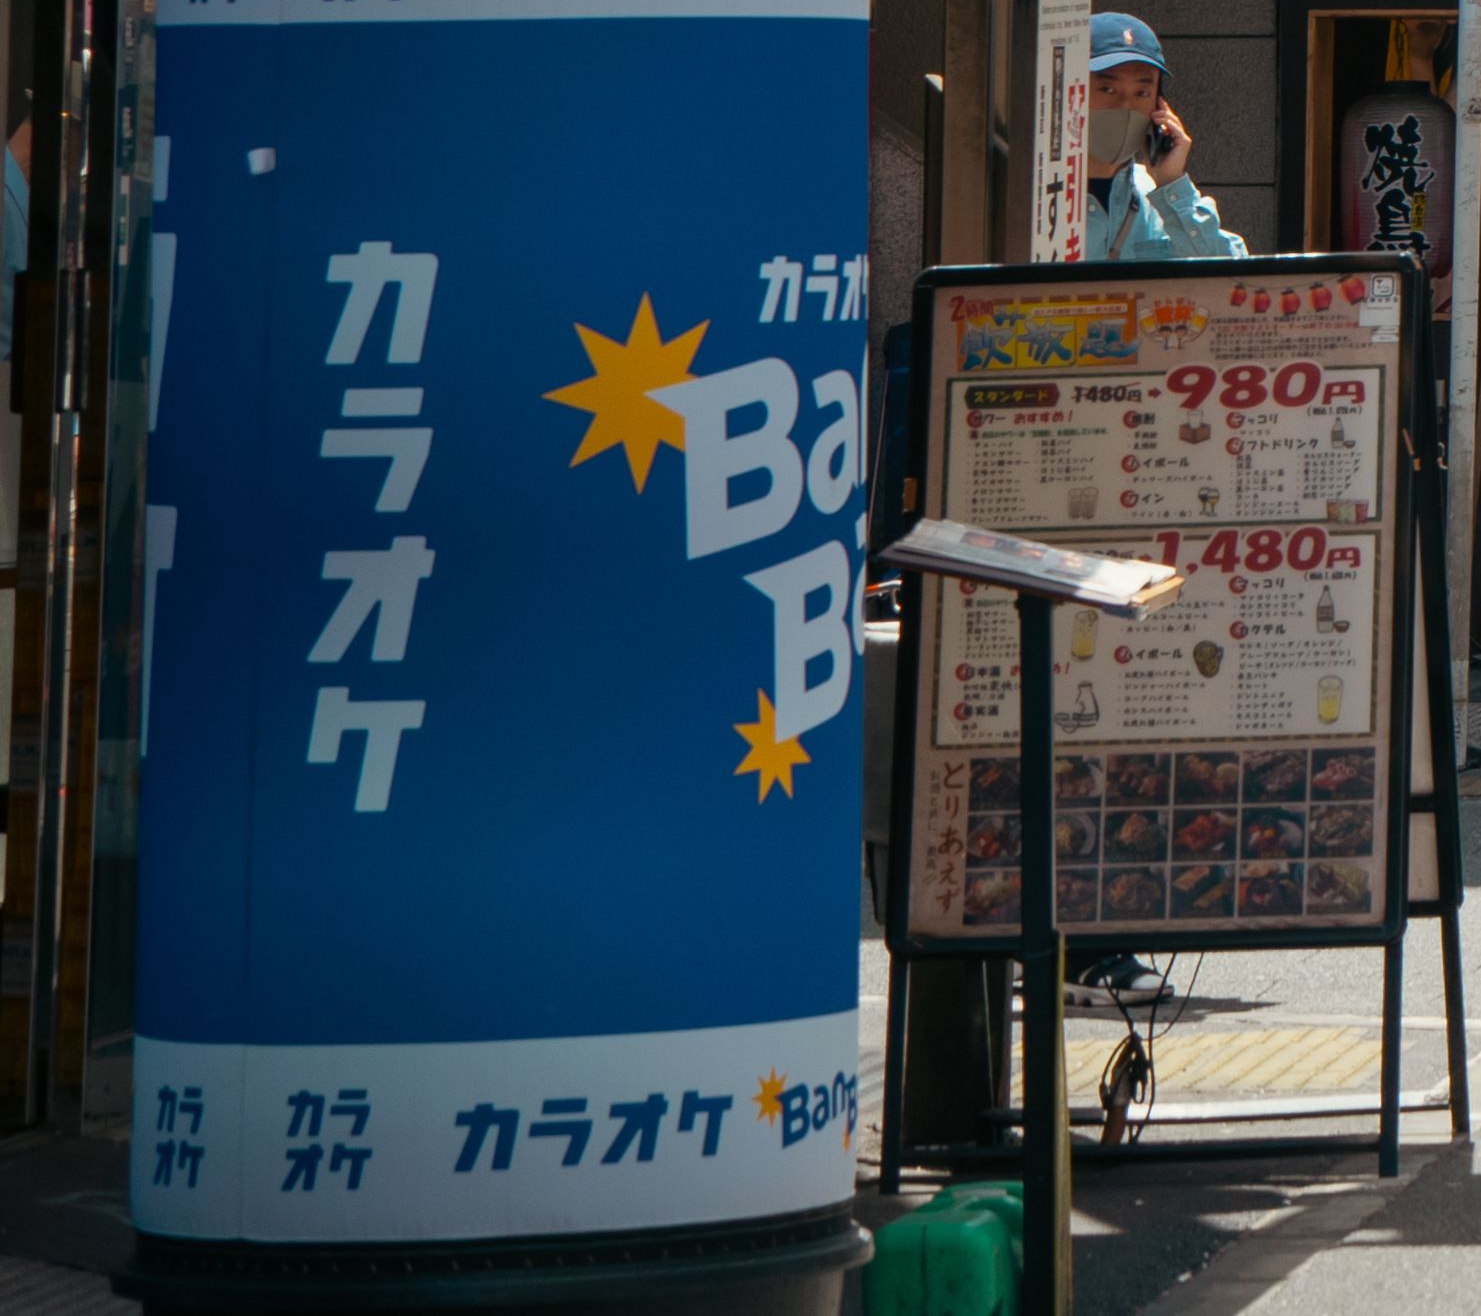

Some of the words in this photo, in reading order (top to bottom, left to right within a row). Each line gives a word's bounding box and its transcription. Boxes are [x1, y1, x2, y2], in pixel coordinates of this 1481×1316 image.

[307, 241, 438, 812] カラオケ
[1154, 527, 1361, 573] 1,480円
[936, 762, 964, 915] とりあえず
[287, 1089, 371, 1138] カラ
[453, 1090, 733, 1174] カラオケ
[281, 1144, 372, 1193] オケ
